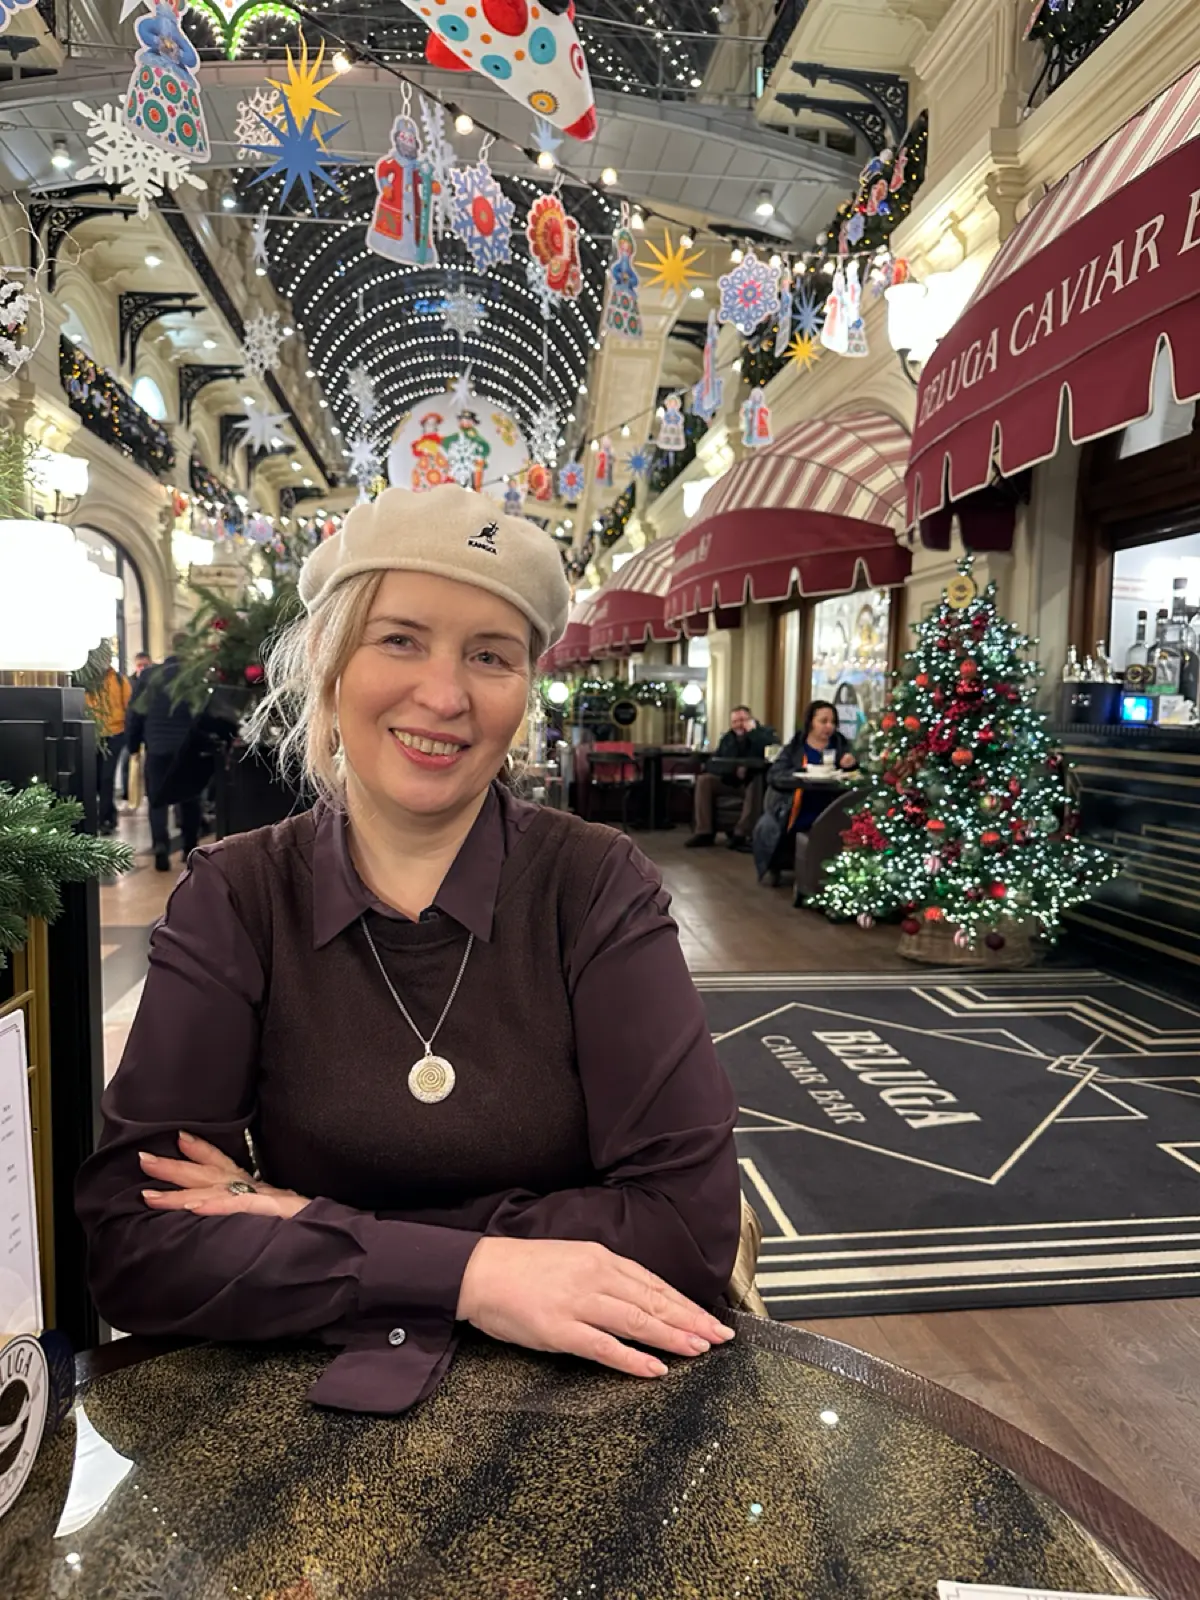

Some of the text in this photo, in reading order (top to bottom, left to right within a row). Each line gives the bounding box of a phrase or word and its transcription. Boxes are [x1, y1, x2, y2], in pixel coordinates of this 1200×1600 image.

[918, 327, 1000, 428] BELUGA
[1009, 213, 1165, 357] CAVIAR
[760, 1034, 867, 1124] CAVIAR BAR
[812, 1029, 982, 1129] BELUGA
